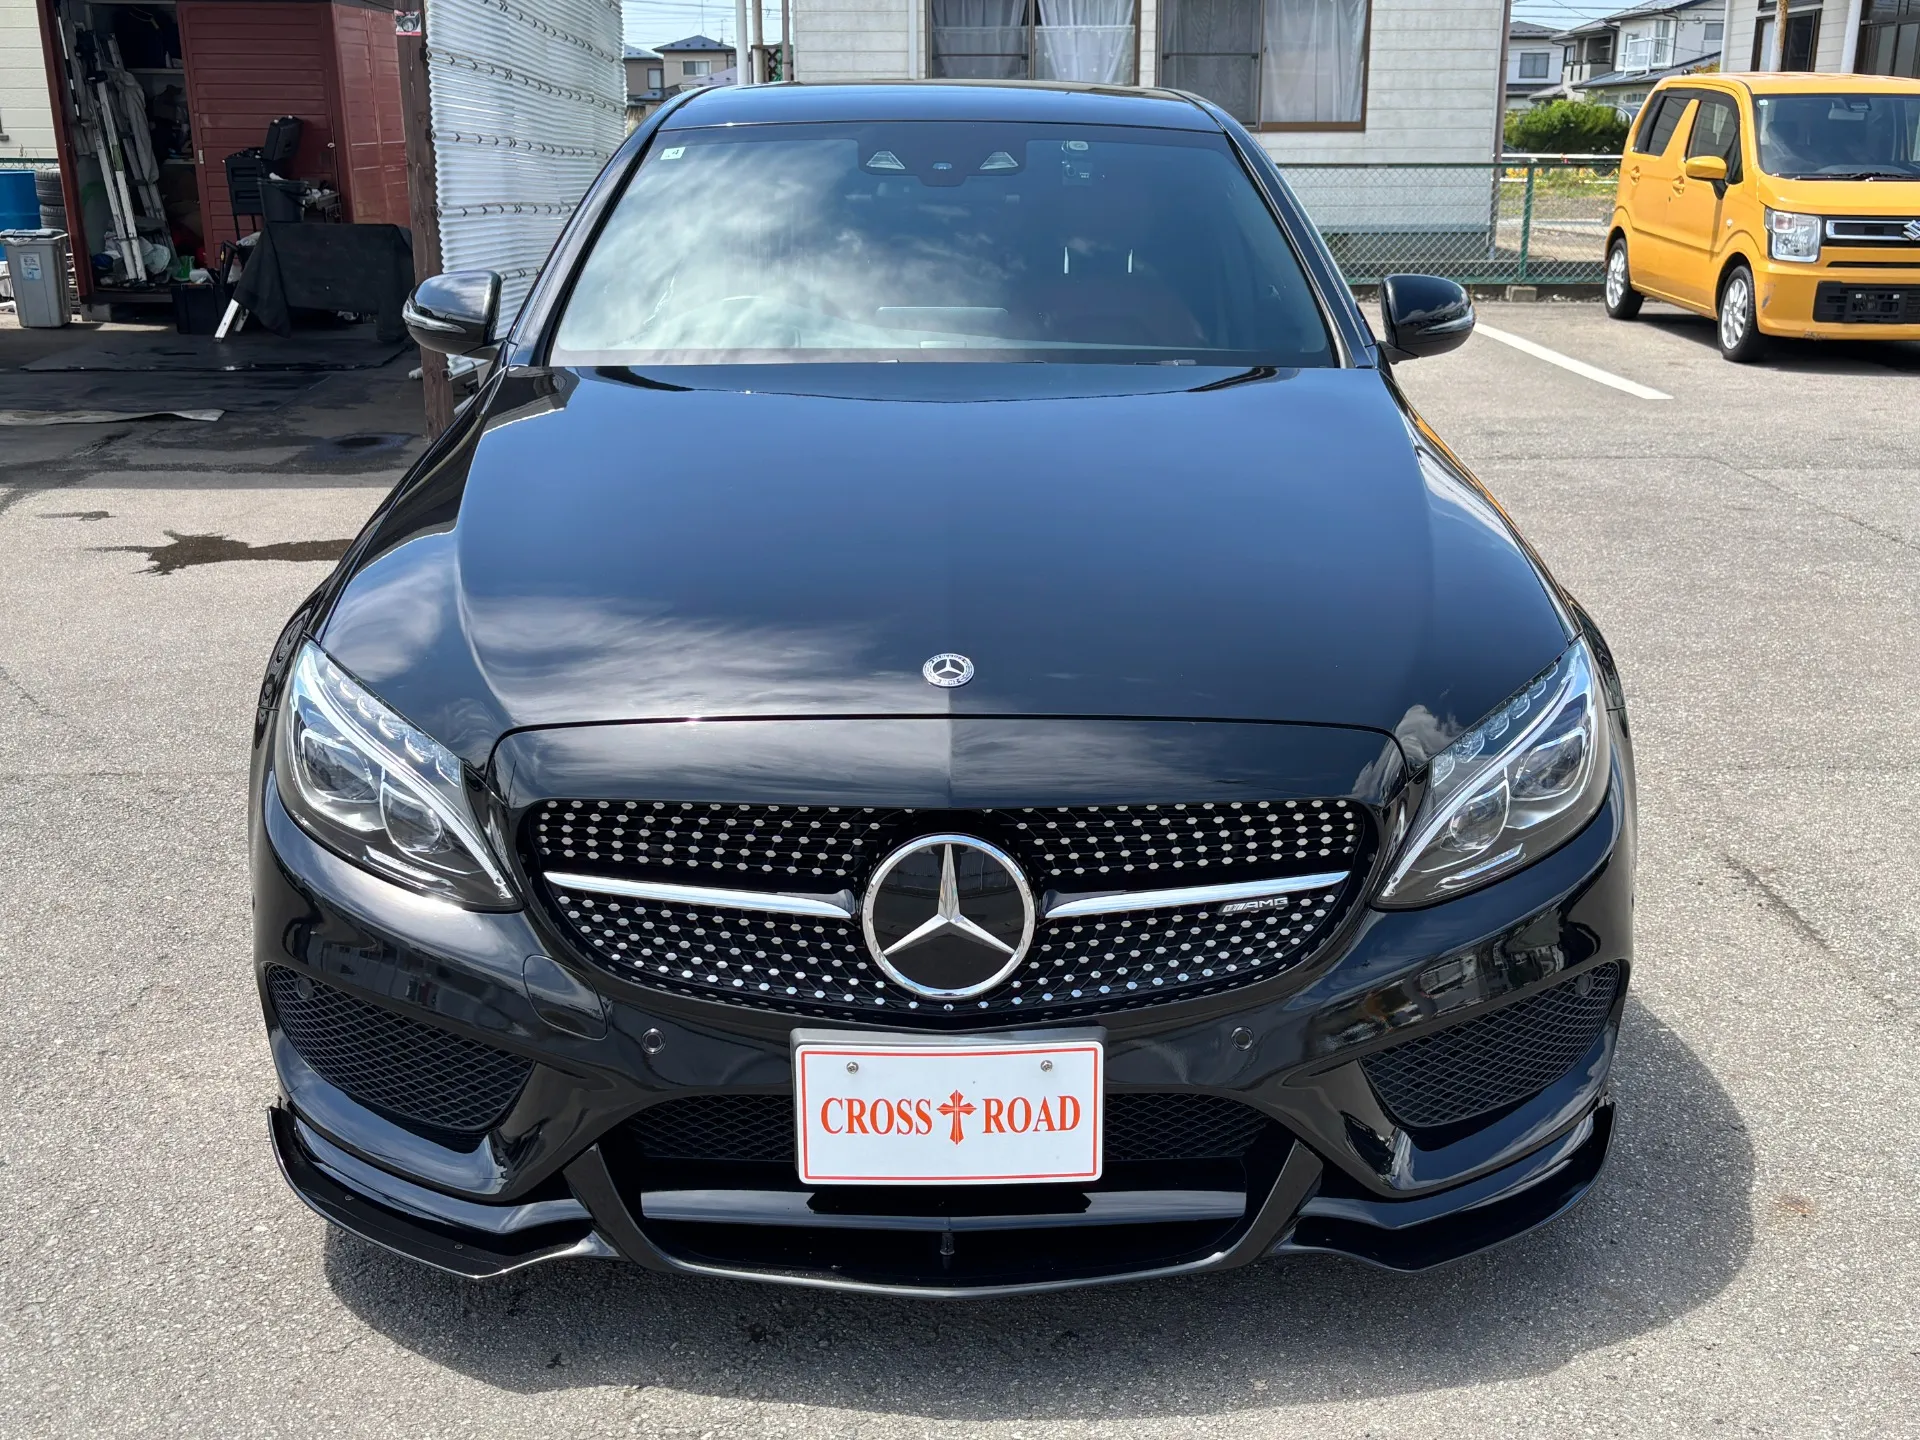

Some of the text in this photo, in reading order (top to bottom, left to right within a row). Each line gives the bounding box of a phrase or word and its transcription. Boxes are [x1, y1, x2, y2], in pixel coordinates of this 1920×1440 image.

[1243, 897, 1289, 909] AMG
[820, 1095, 1081, 1135] CROSS ROAD
